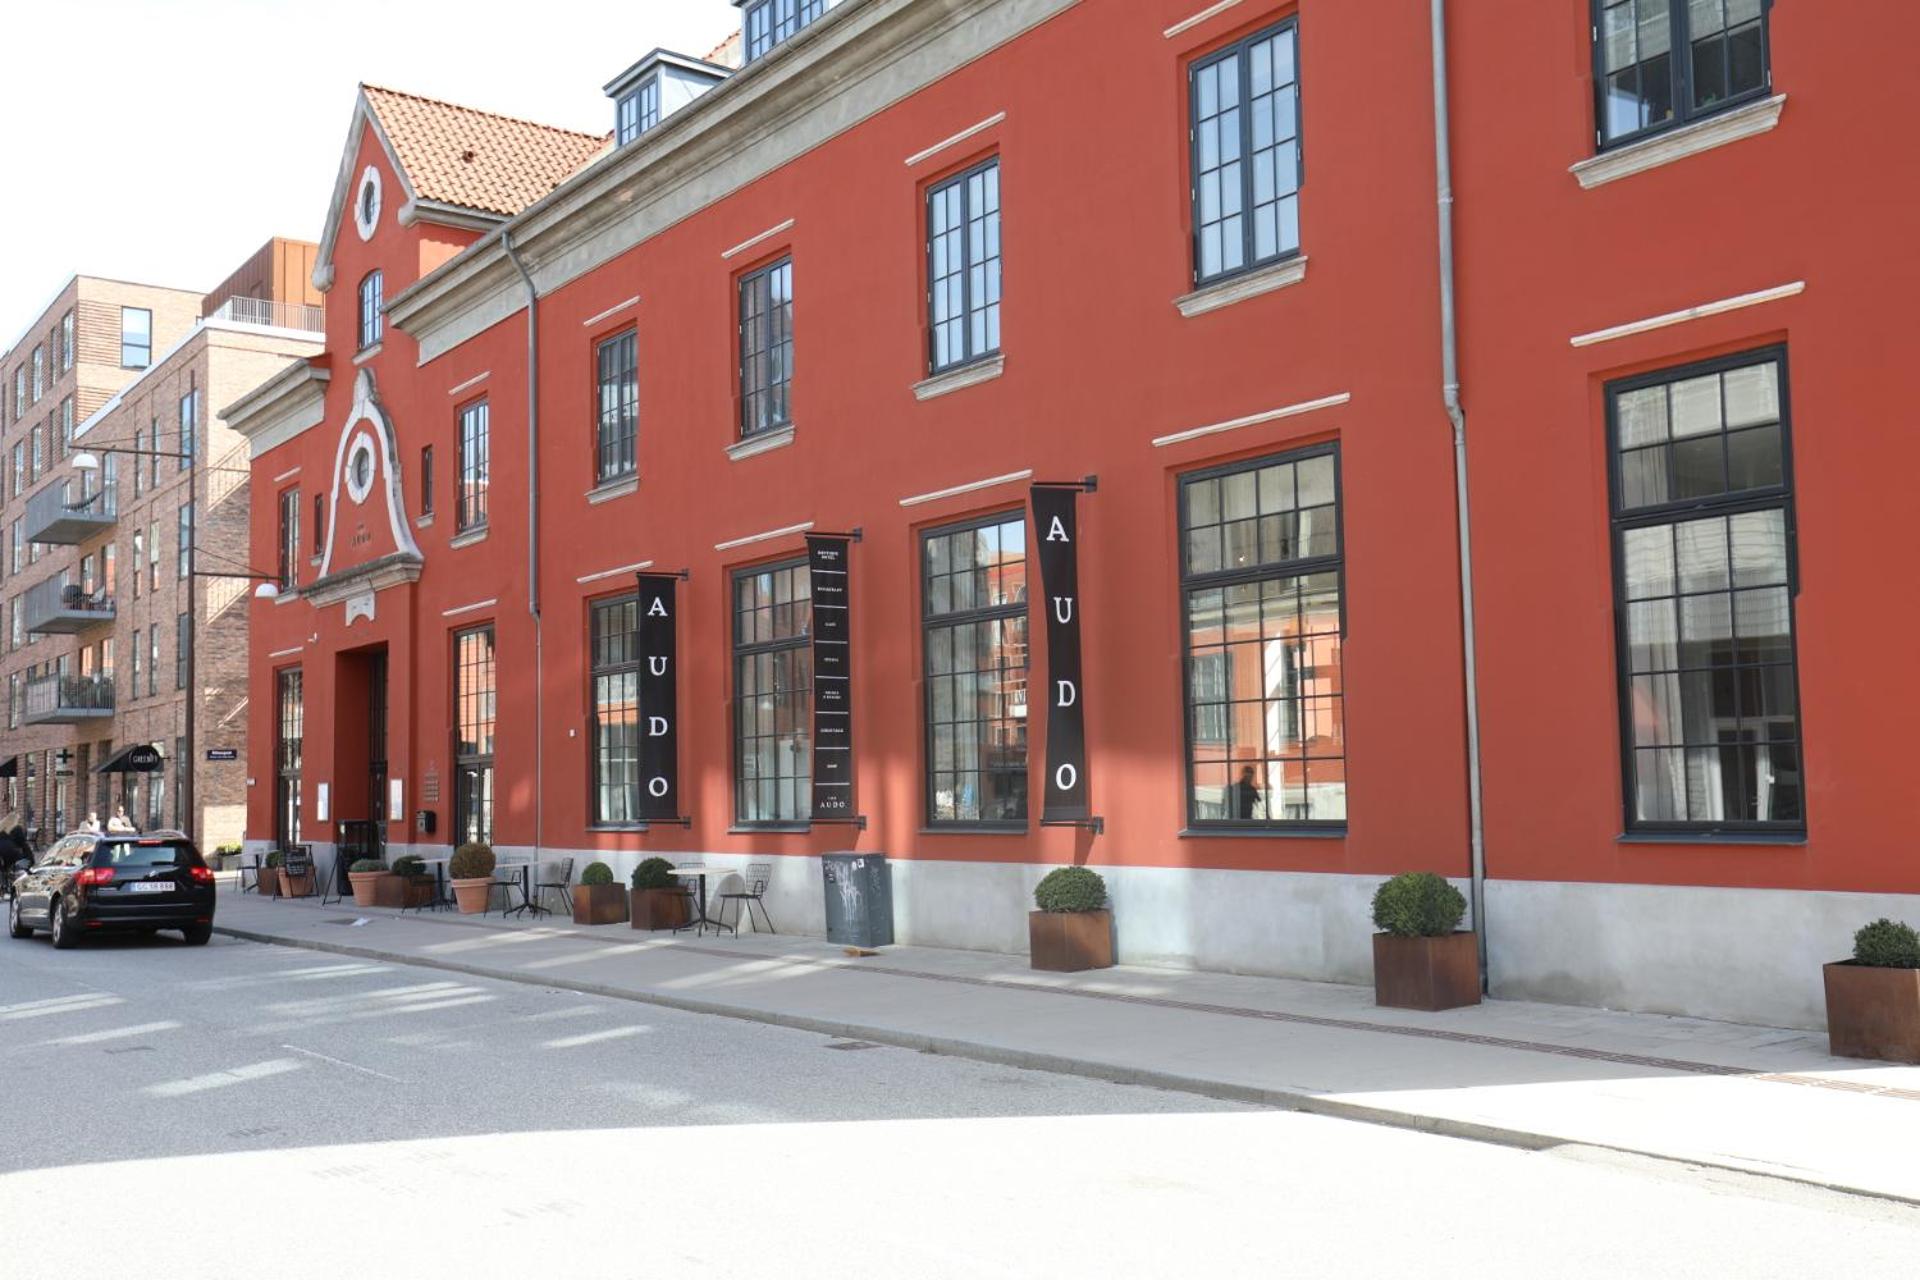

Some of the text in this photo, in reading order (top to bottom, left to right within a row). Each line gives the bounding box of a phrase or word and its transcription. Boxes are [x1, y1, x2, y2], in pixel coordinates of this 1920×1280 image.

[647, 597, 668, 797] AUDO
[1046, 515, 1077, 791] AUDO
[820, 801, 845, 809] AUDO
